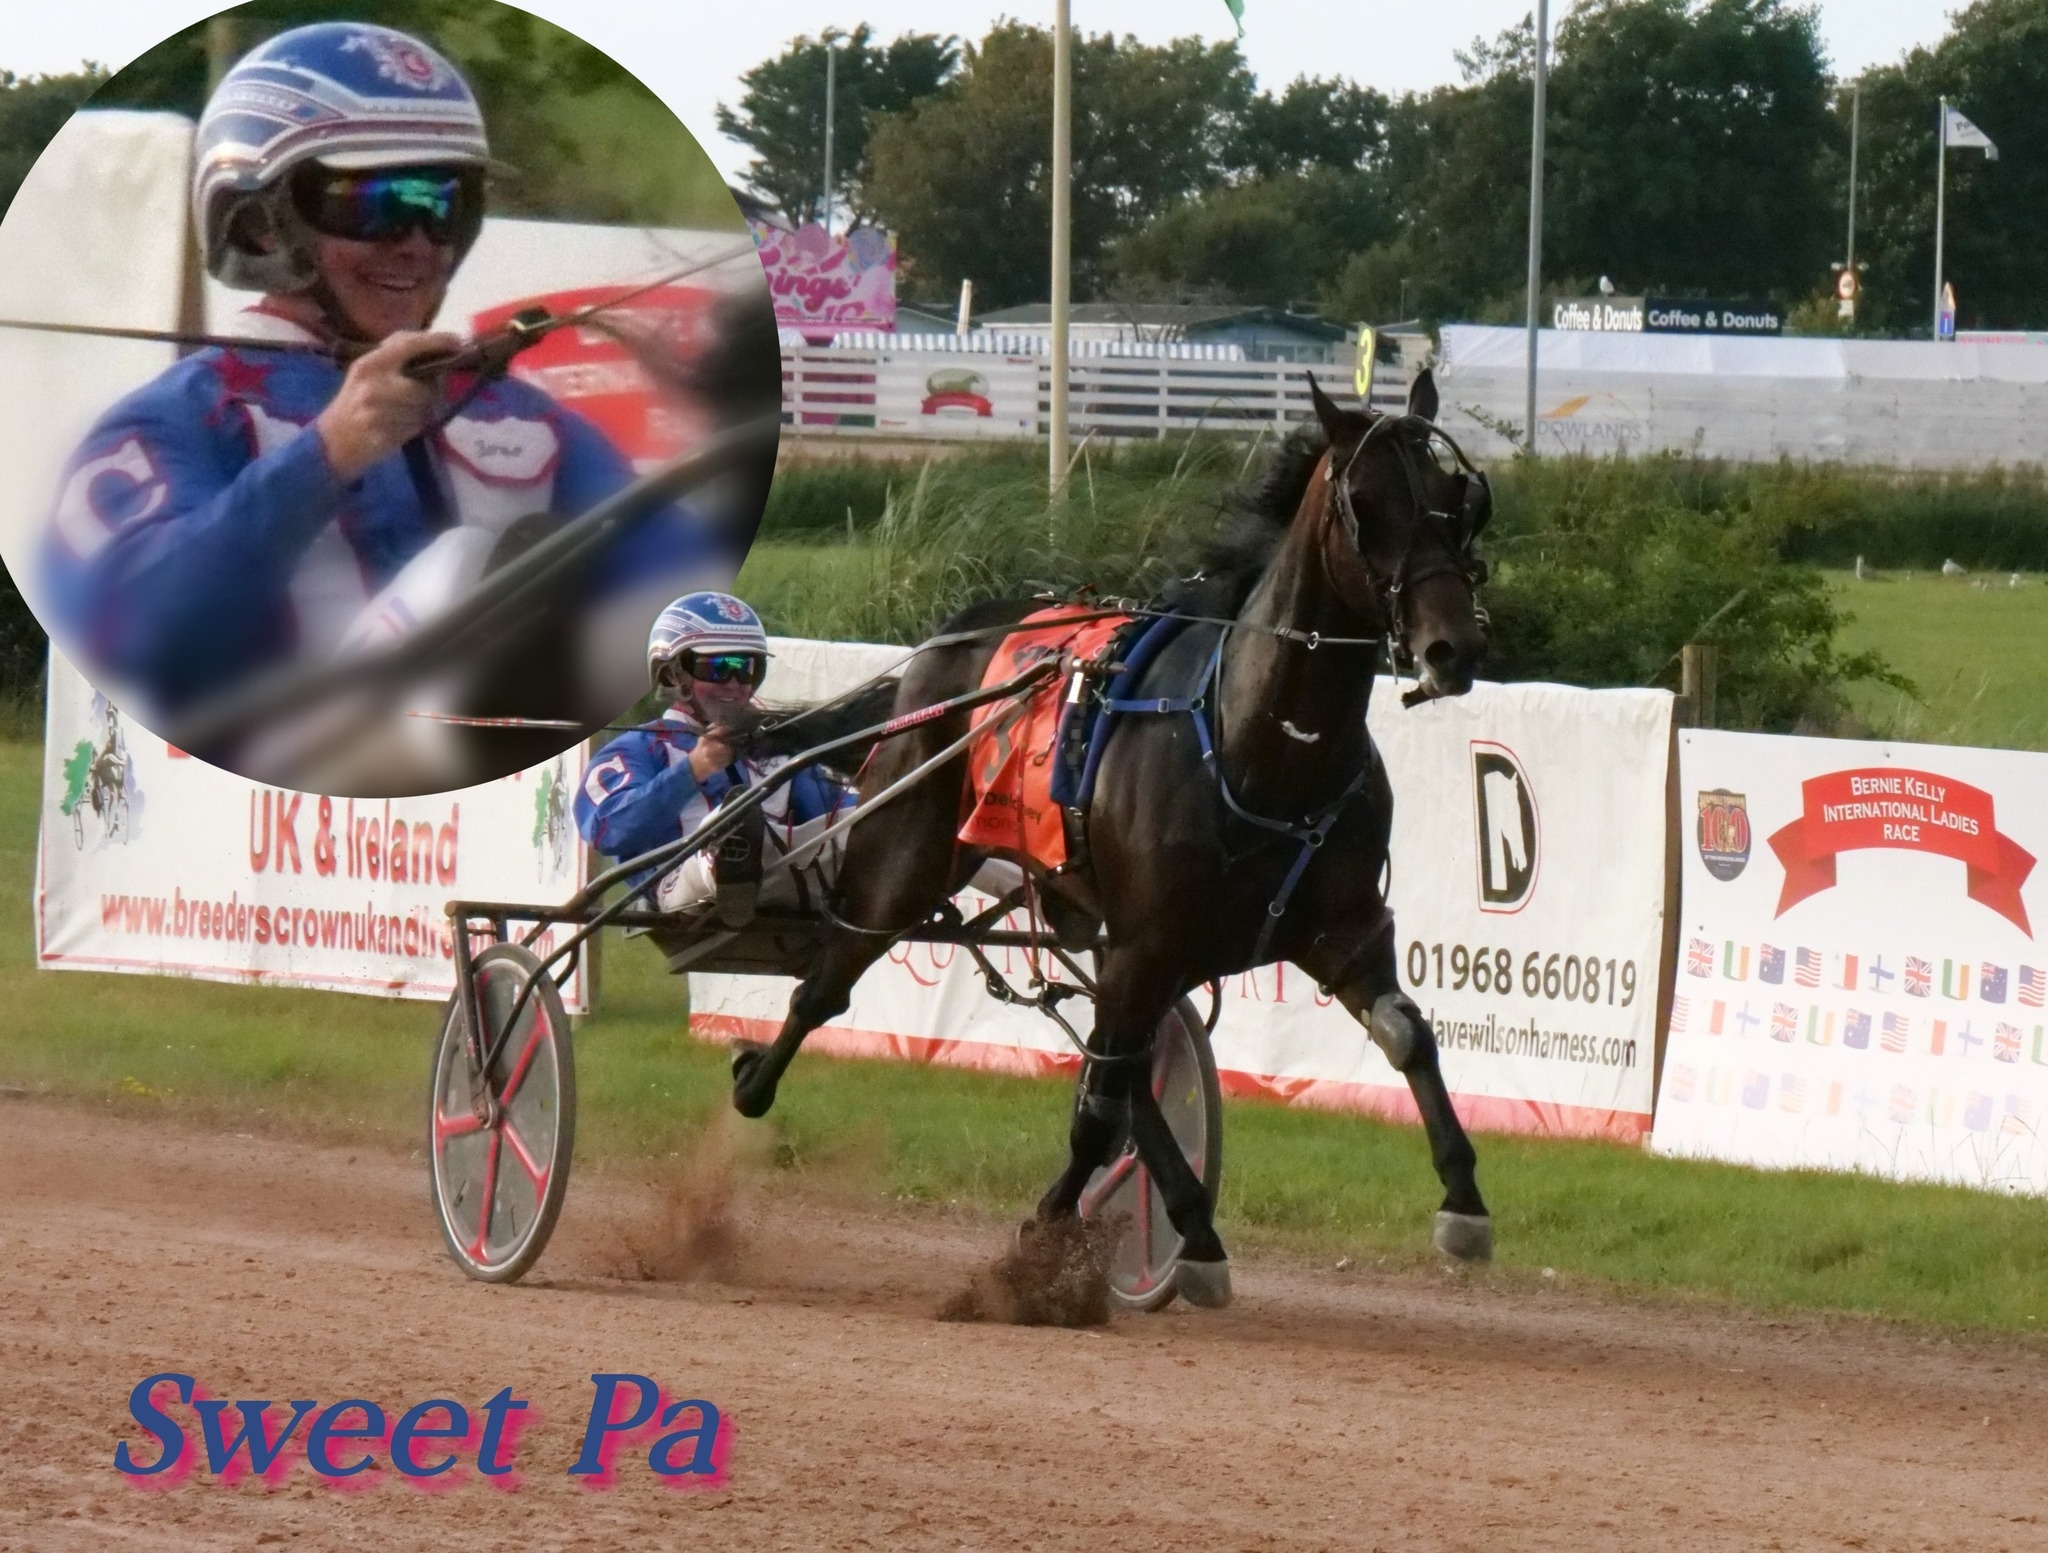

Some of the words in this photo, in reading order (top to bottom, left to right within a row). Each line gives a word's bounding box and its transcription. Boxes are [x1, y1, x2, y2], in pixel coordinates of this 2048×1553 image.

[1554, 303, 1590, 330] Coffee
[1592, 303, 1602, 330] &
[1604, 304, 1642, 331] Donuts
[1648, 309, 1700, 327] Coffee
[1704, 311, 1718, 328] &
[1722, 311, 1778, 329] Donuts
[1355, 328, 1373, 395] 3
[1850, 776, 1902, 796] BERNIE
[1904, 776, 1946, 803] KELLY
[1823, 801, 1928, 823] INTERNATIONAL
[1930, 804, 1979, 836] LADIES
[1883, 823, 1920, 842] RACE
[249, 788, 303, 874] UK
[314, 795, 338, 878] &
[346, 797, 460, 886] Ireland
[1407, 940, 1513, 996] 01968
[1522, 951, 1637, 1007] 660819
